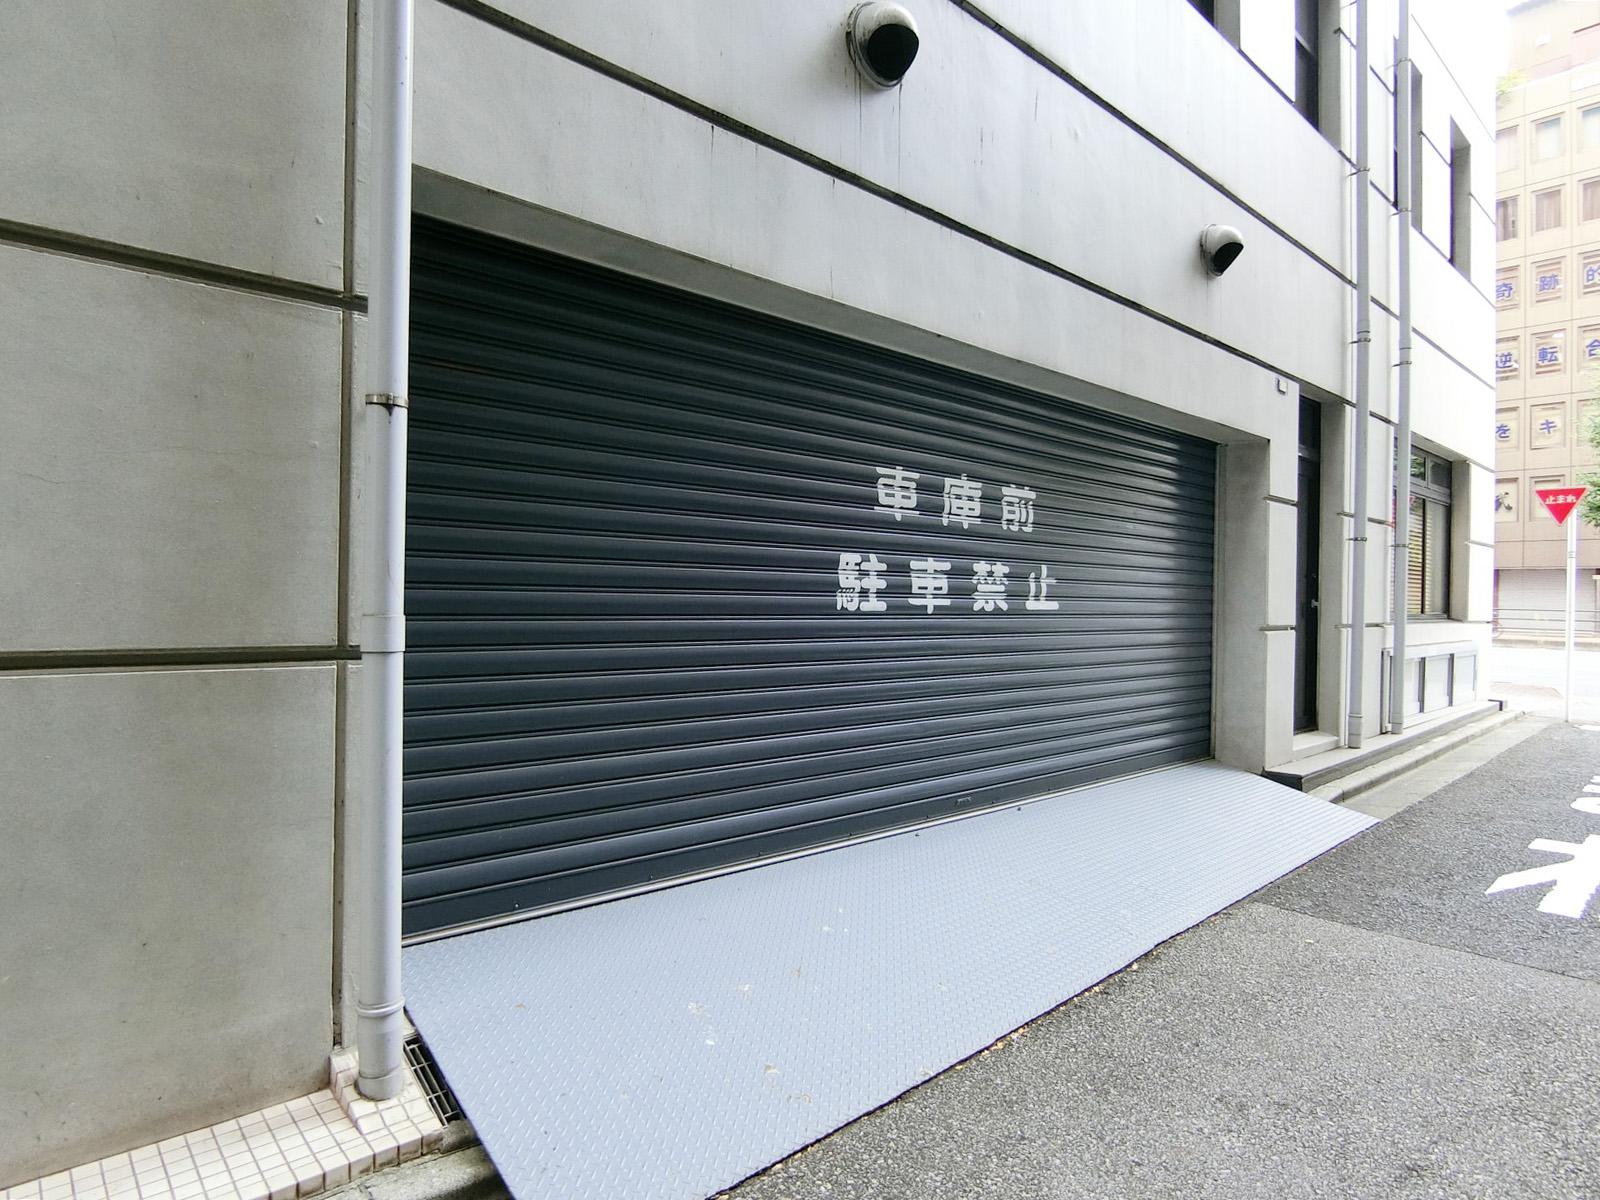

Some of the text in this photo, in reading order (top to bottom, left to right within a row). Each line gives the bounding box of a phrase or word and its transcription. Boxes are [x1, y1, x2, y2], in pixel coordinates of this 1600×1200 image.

[873, 466, 1036, 533] 車庫前
[1544, 494, 1577, 505] 止まれ
[836, 553, 1060, 614] 駐車禁止
